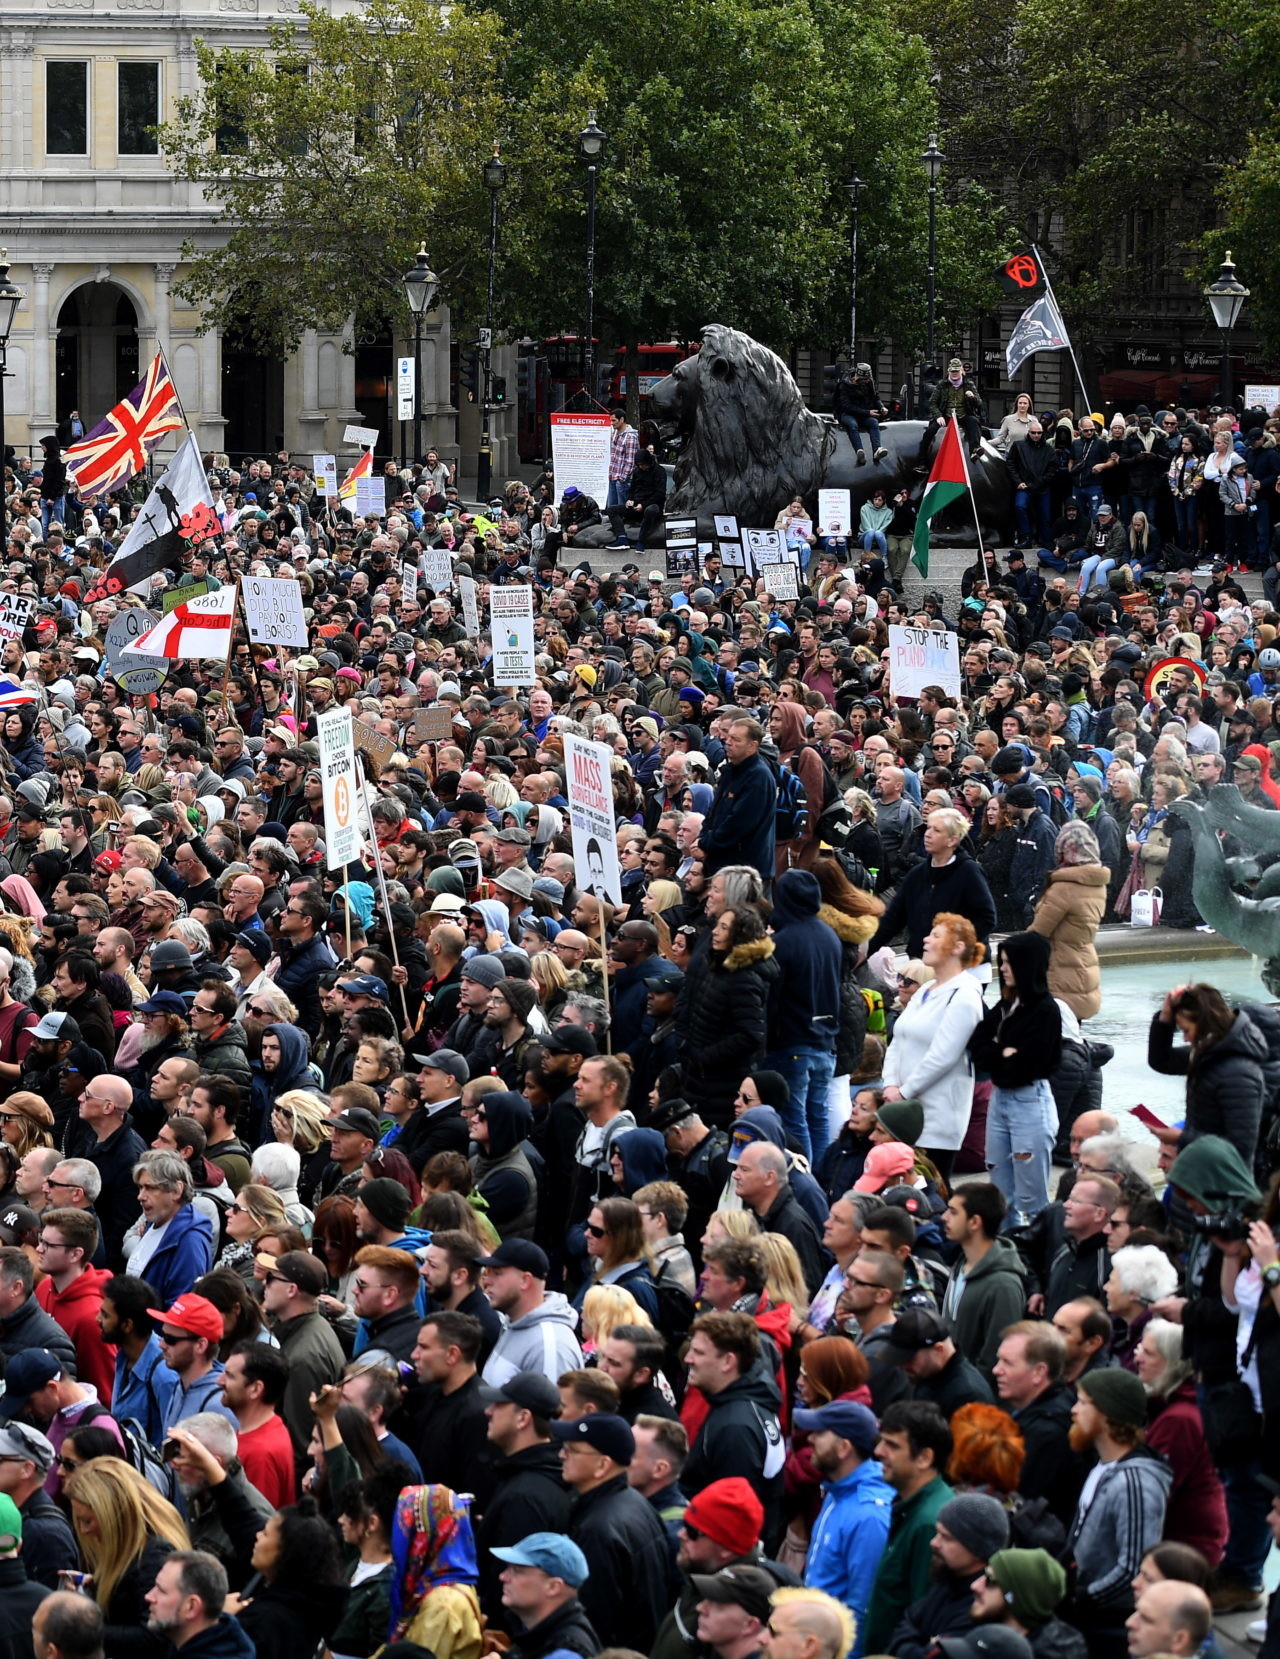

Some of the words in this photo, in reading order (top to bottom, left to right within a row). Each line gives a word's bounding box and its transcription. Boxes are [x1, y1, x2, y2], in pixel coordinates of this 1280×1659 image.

[425, 553, 434, 561] NO
[437, 553, 448, 561] VAX
[247, 582, 267, 598] HOW
[272, 583, 297, 598] MUCH
[250, 598, 270, 612] DID
[273, 599, 299, 614] BILL
[494, 596, 507, 605] COVID
[514, 595, 528, 604] CASES
[126, 614, 140, 636] Q
[258, 612, 273, 624] PAY
[274, 612, 292, 624] YOU
[264, 624, 298, 640] BORIS?
[904, 628, 929, 646] STOP
[932, 631, 949, 650] THE
[510, 656, 523, 666] TESTS
[897, 646, 954, 671] PLAND
[324, 723, 350, 752] FREEDOM
[353, 722, 388, 753] LOVE
[332, 750, 346, 761] CHOOSE
[328, 758, 350, 778] BITCOIN
[573, 752, 602, 793] MASS
[571, 784, 608, 814] SURVEILLANCE
